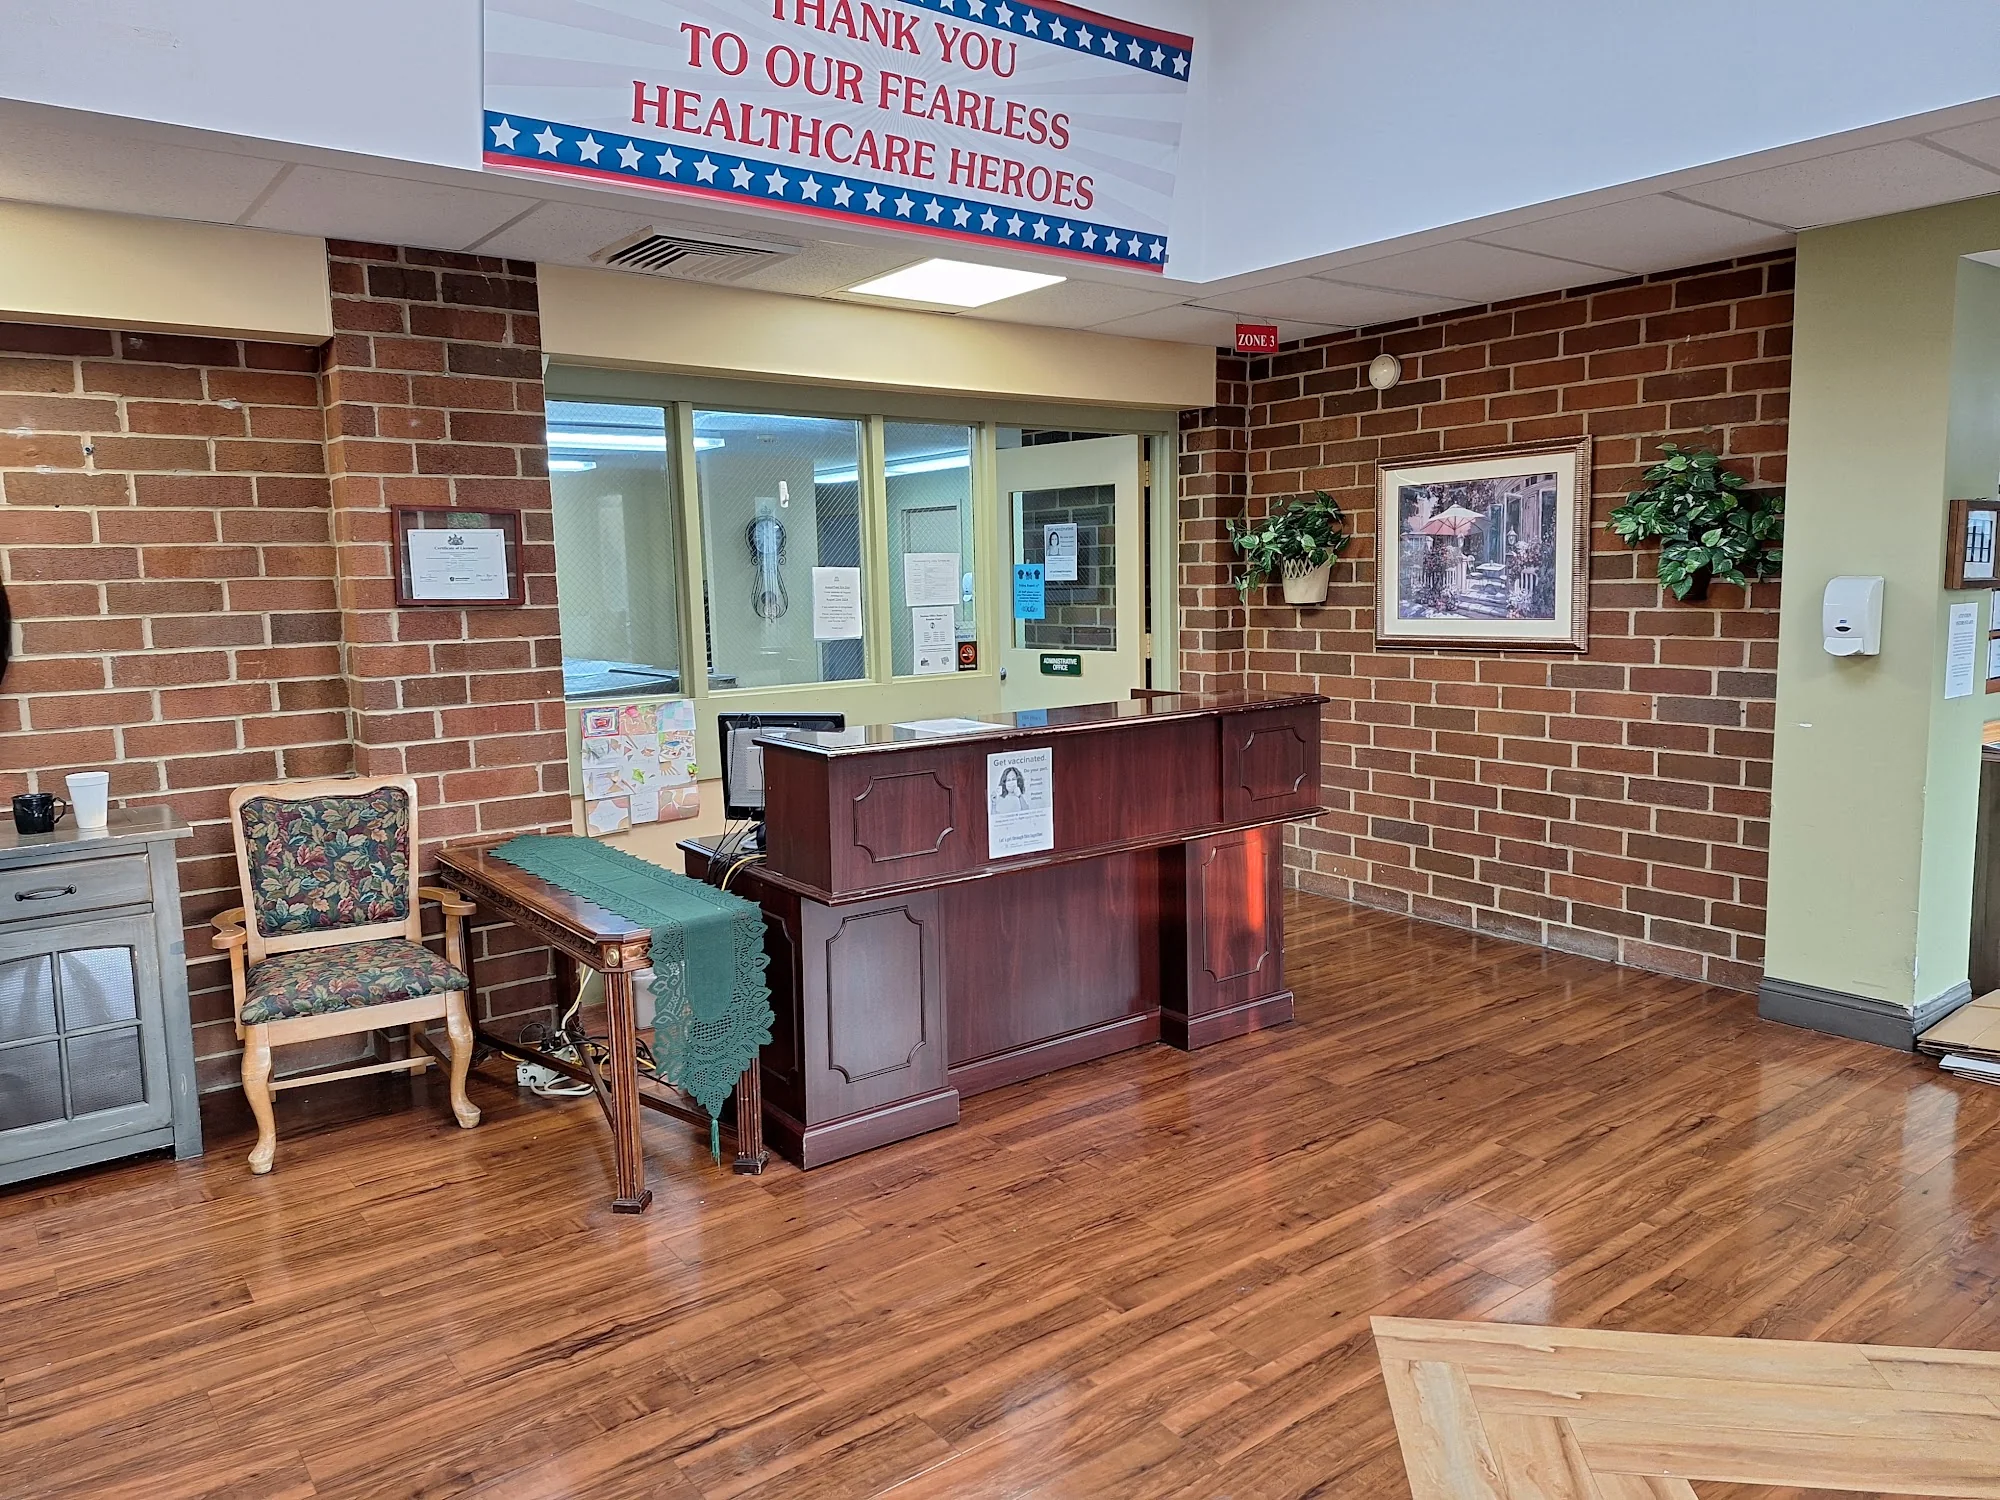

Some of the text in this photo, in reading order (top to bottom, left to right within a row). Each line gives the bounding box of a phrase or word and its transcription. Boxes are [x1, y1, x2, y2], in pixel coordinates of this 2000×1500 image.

[934, 21, 1017, 78] YOU
[680, 22, 1071, 150] TO OUR FEARLESS
[631, 80, 1096, 211] HEALTHCARE HEROES
[1237, 333, 1275, 348] ZONE 3
[1042, 657, 1078, 666] ADMINISTRATIVE
[993, 754, 1047, 767] Get vaccinated.
